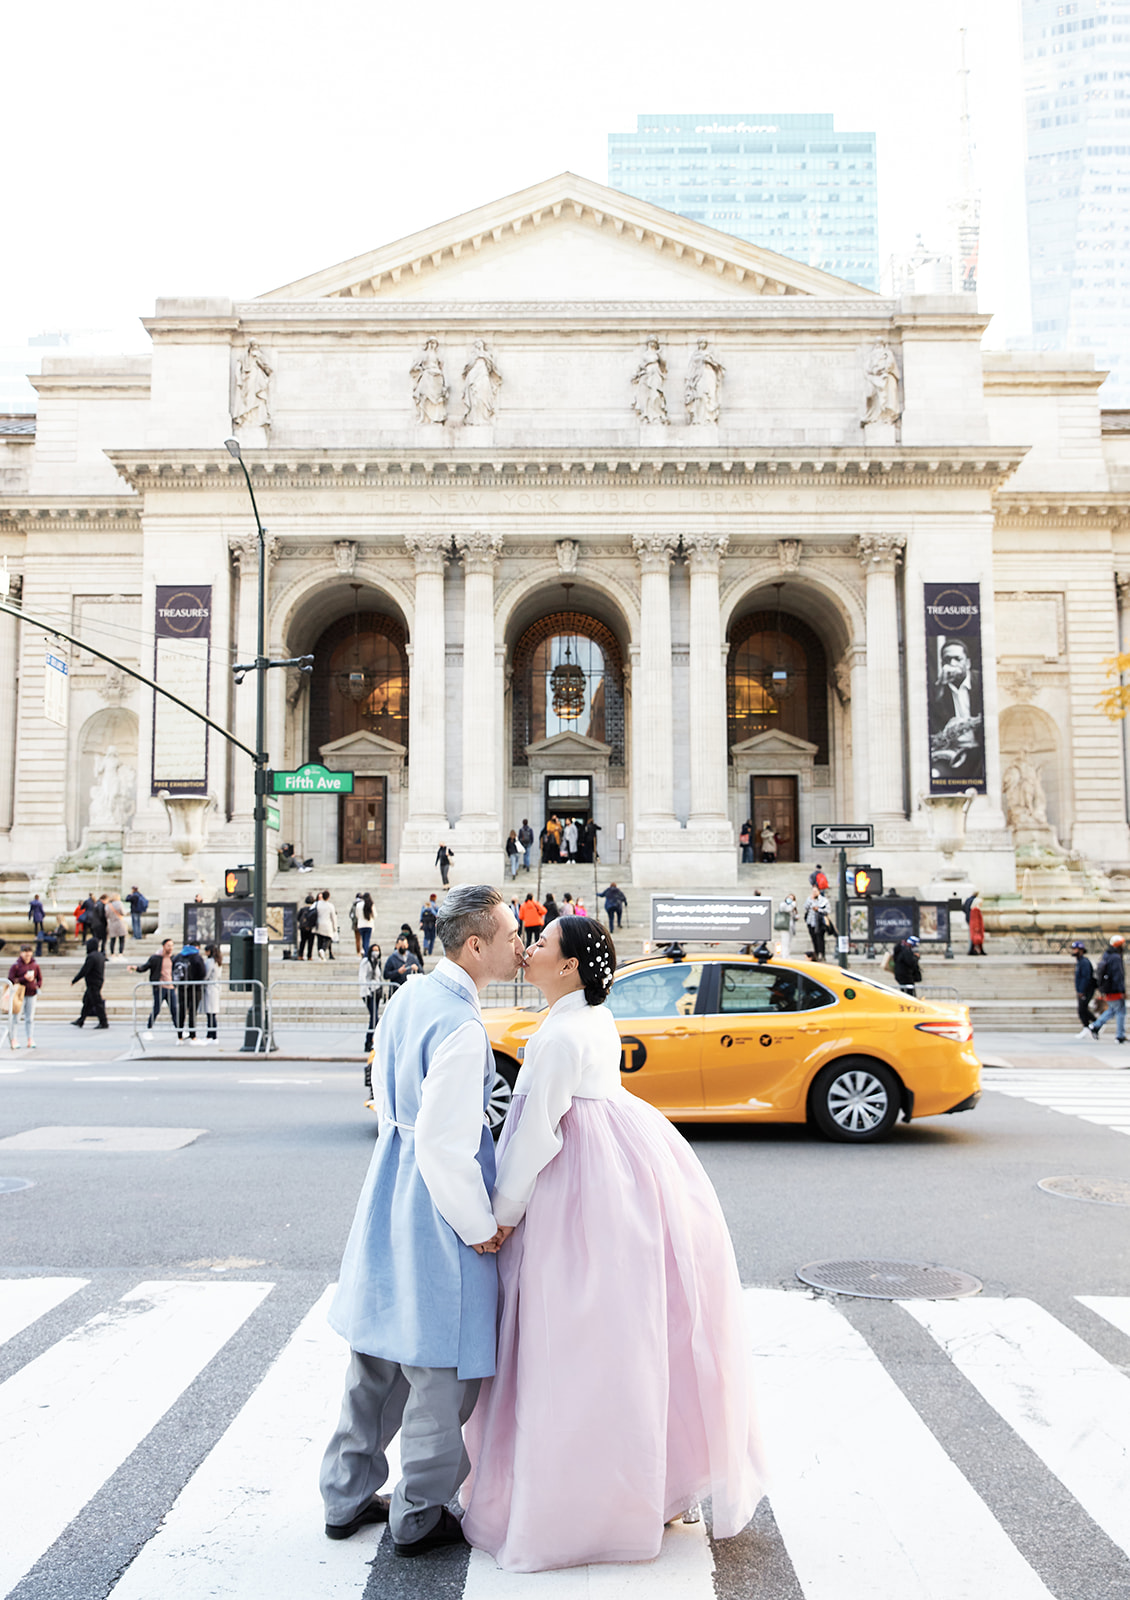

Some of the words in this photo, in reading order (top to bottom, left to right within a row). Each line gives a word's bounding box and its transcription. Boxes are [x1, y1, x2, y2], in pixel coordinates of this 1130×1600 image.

[366, 493, 411, 509] THE
[429, 493, 483, 509] NEW
[503, 493, 560, 509] YORK
[579, 493, 656, 508] PUBLIC
[678, 492, 769, 508] LIBRARY
[158, 609, 209, 617] TREASURES
[927, 605, 978, 615] TREASURES
[285, 776, 314, 789] Fifth
[316, 777, 342, 789] Ave
[823, 832, 837, 840] ONE
